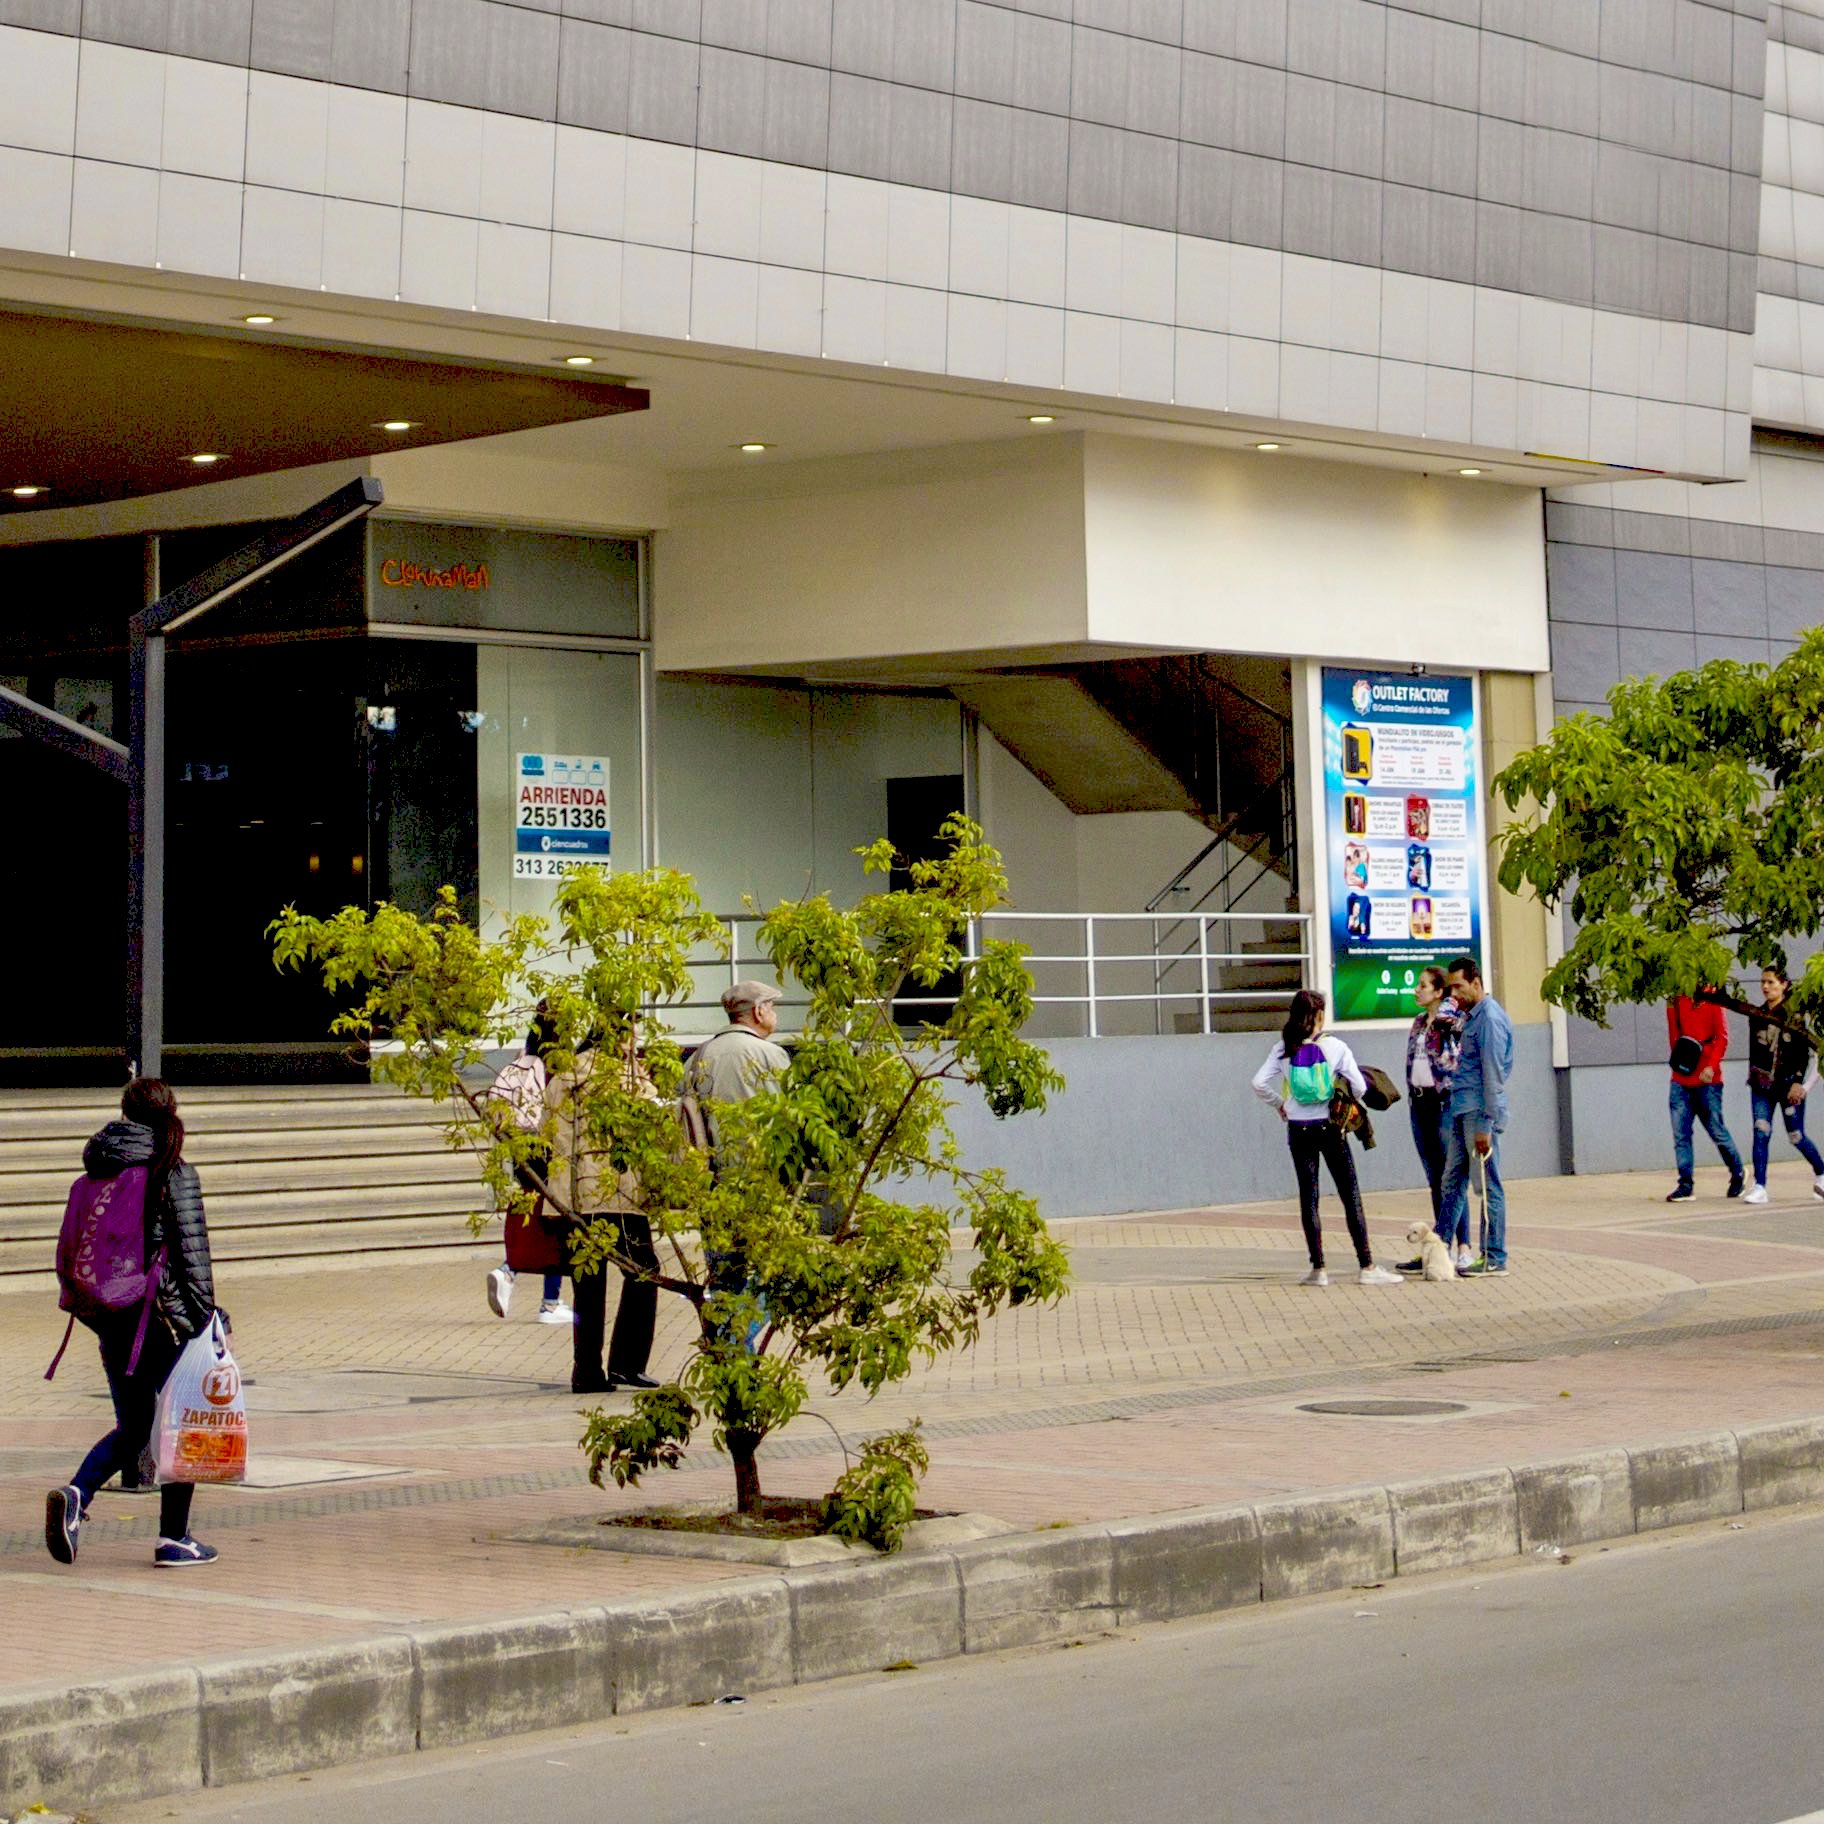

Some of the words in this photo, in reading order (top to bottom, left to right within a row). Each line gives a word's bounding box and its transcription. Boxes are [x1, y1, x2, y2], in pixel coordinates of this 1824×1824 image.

[1372, 685, 1408, 701] OUTLET
[1409, 687, 1450, 703] FACTORY
[520, 786, 606, 806] ARRIENDA
[522, 806, 606, 829] 2551336
[516, 858, 542, 875] 313
[183, 1408, 246, 1426] ZAPATOC
